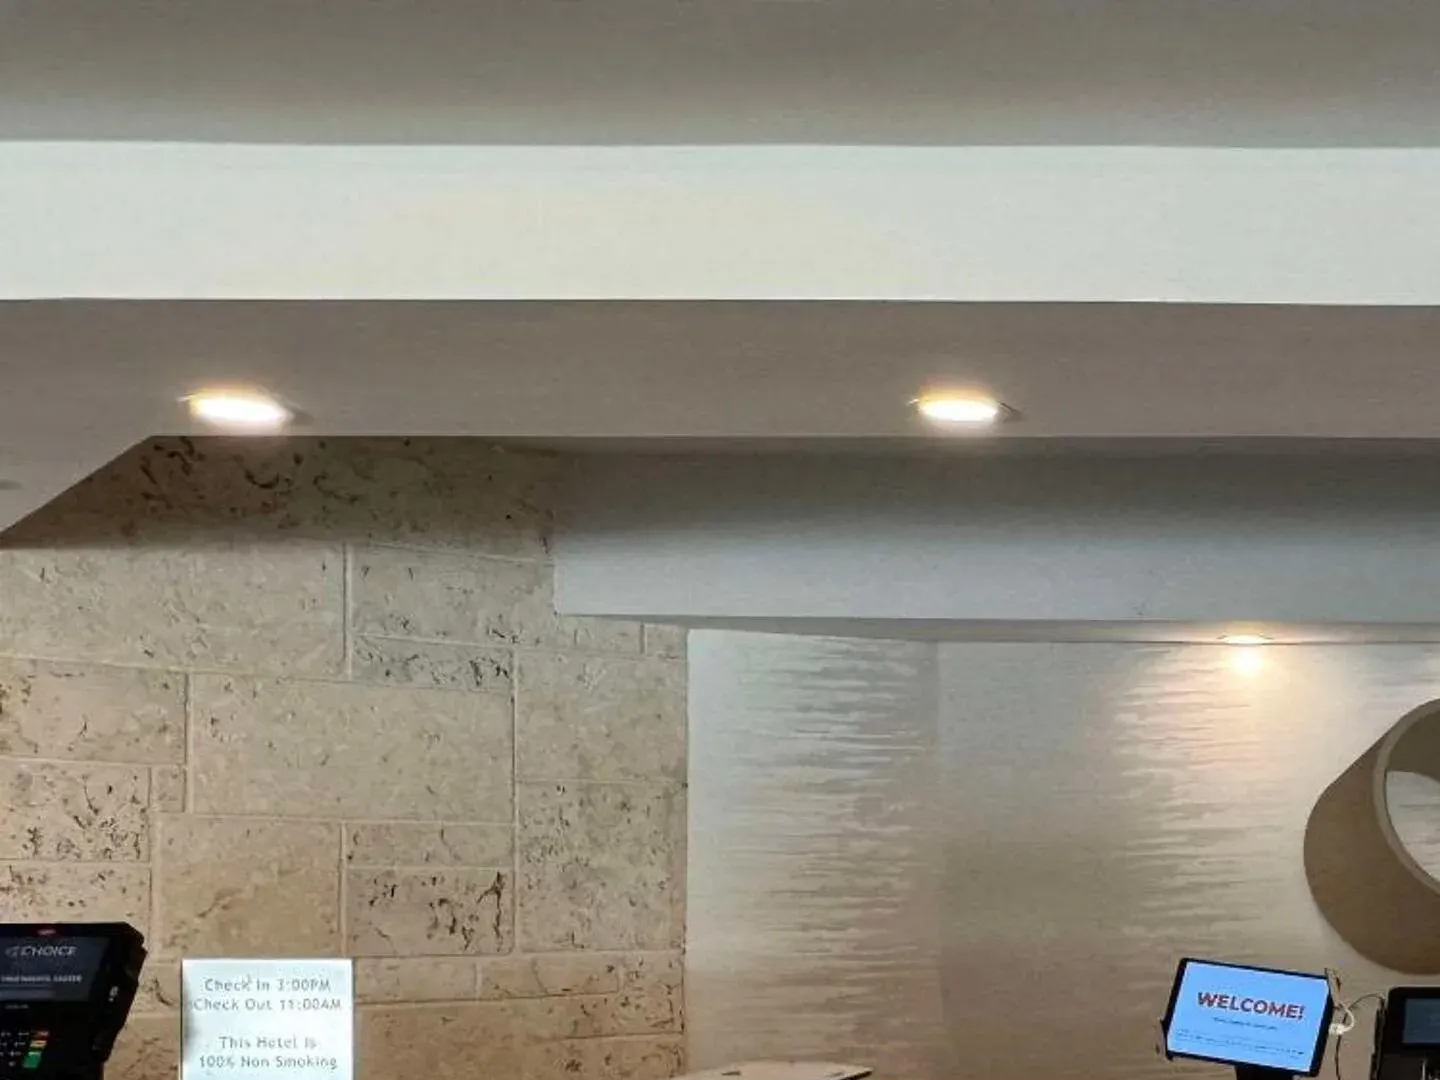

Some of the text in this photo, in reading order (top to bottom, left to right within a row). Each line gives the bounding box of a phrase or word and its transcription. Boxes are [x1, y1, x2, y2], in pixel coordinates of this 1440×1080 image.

[204, 977, 251, 992] Check
[256, 978, 270, 992] In
[193, 998, 341, 1011] Check Out 11:00AM
[1197, 991, 1305, 1020] WELCOME!
[218, 1036, 251, 1049] This
[256, 1034, 298, 1049] Hotel
[200, 1055, 338, 1071] 100% Non Smoking
